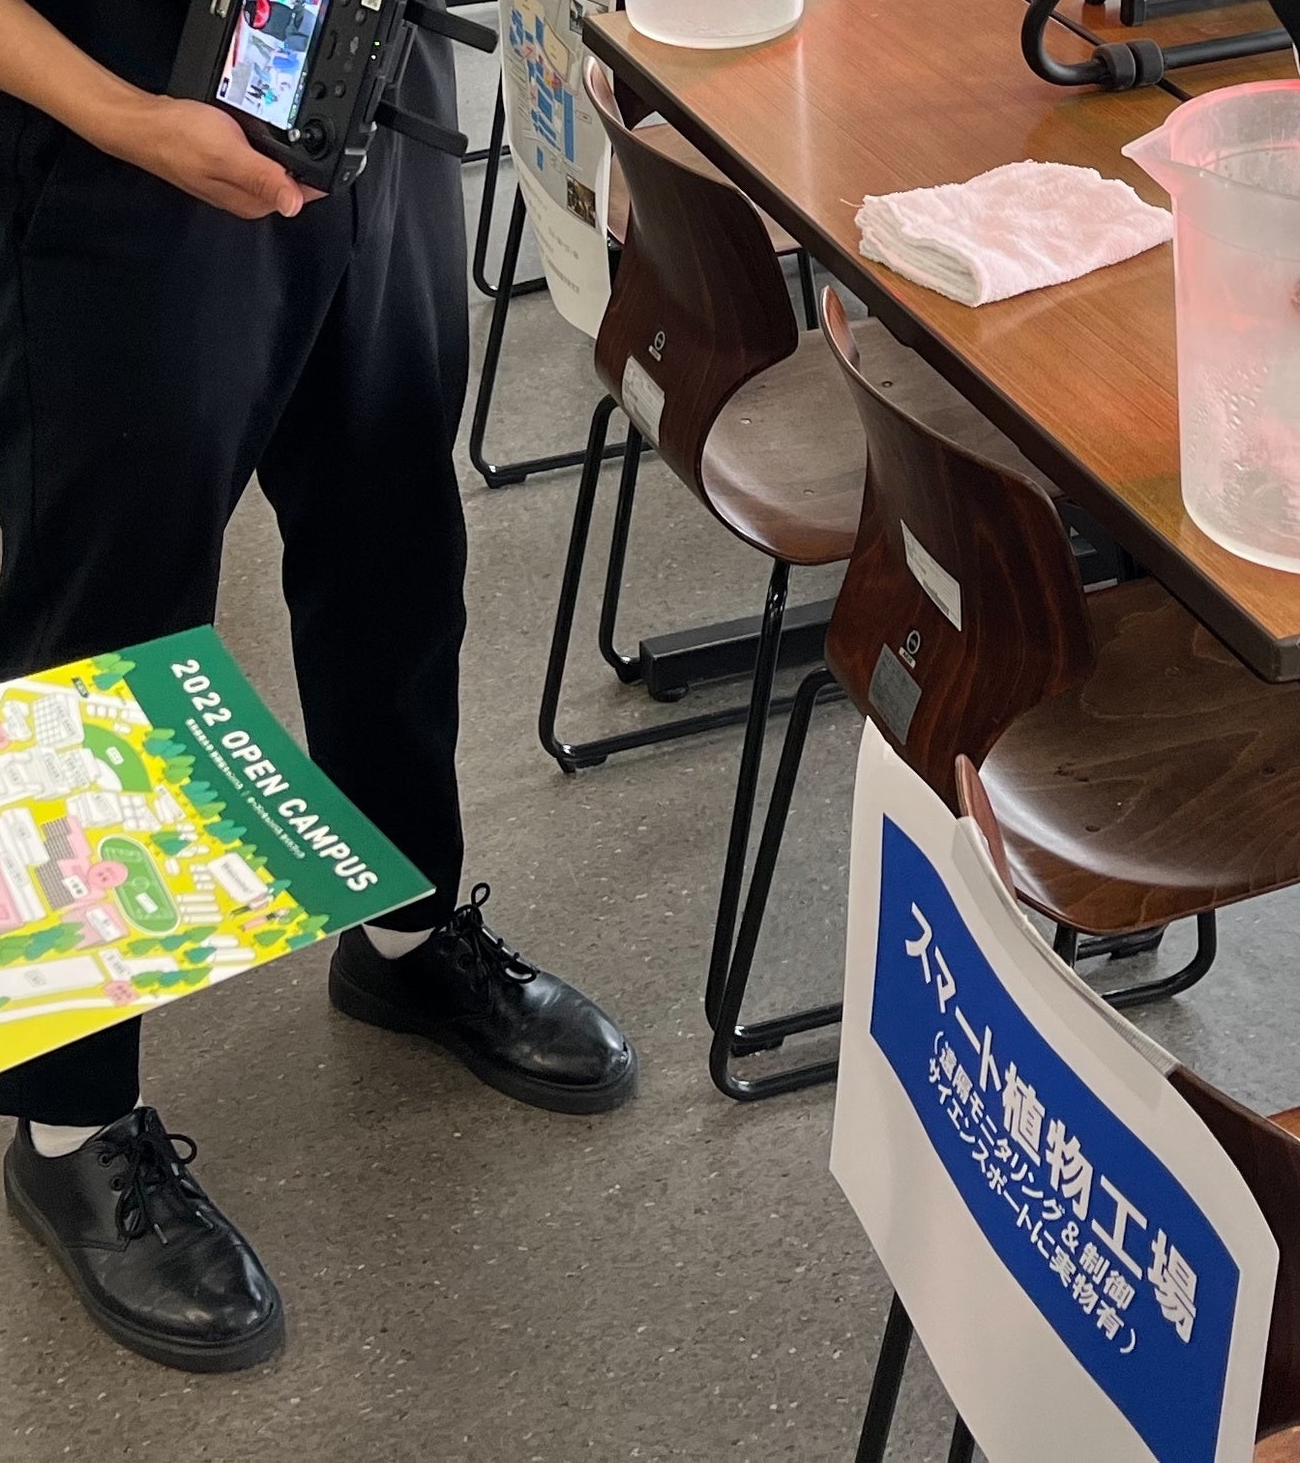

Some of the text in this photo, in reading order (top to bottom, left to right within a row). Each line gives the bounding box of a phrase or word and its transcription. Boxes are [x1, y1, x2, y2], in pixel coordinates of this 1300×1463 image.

[171, 659, 232, 727] 2022
[222, 730, 290, 798] OPEN
[278, 798, 379, 892] CAMPUS
[904, 902, 1198, 1345] スマート植物工場
